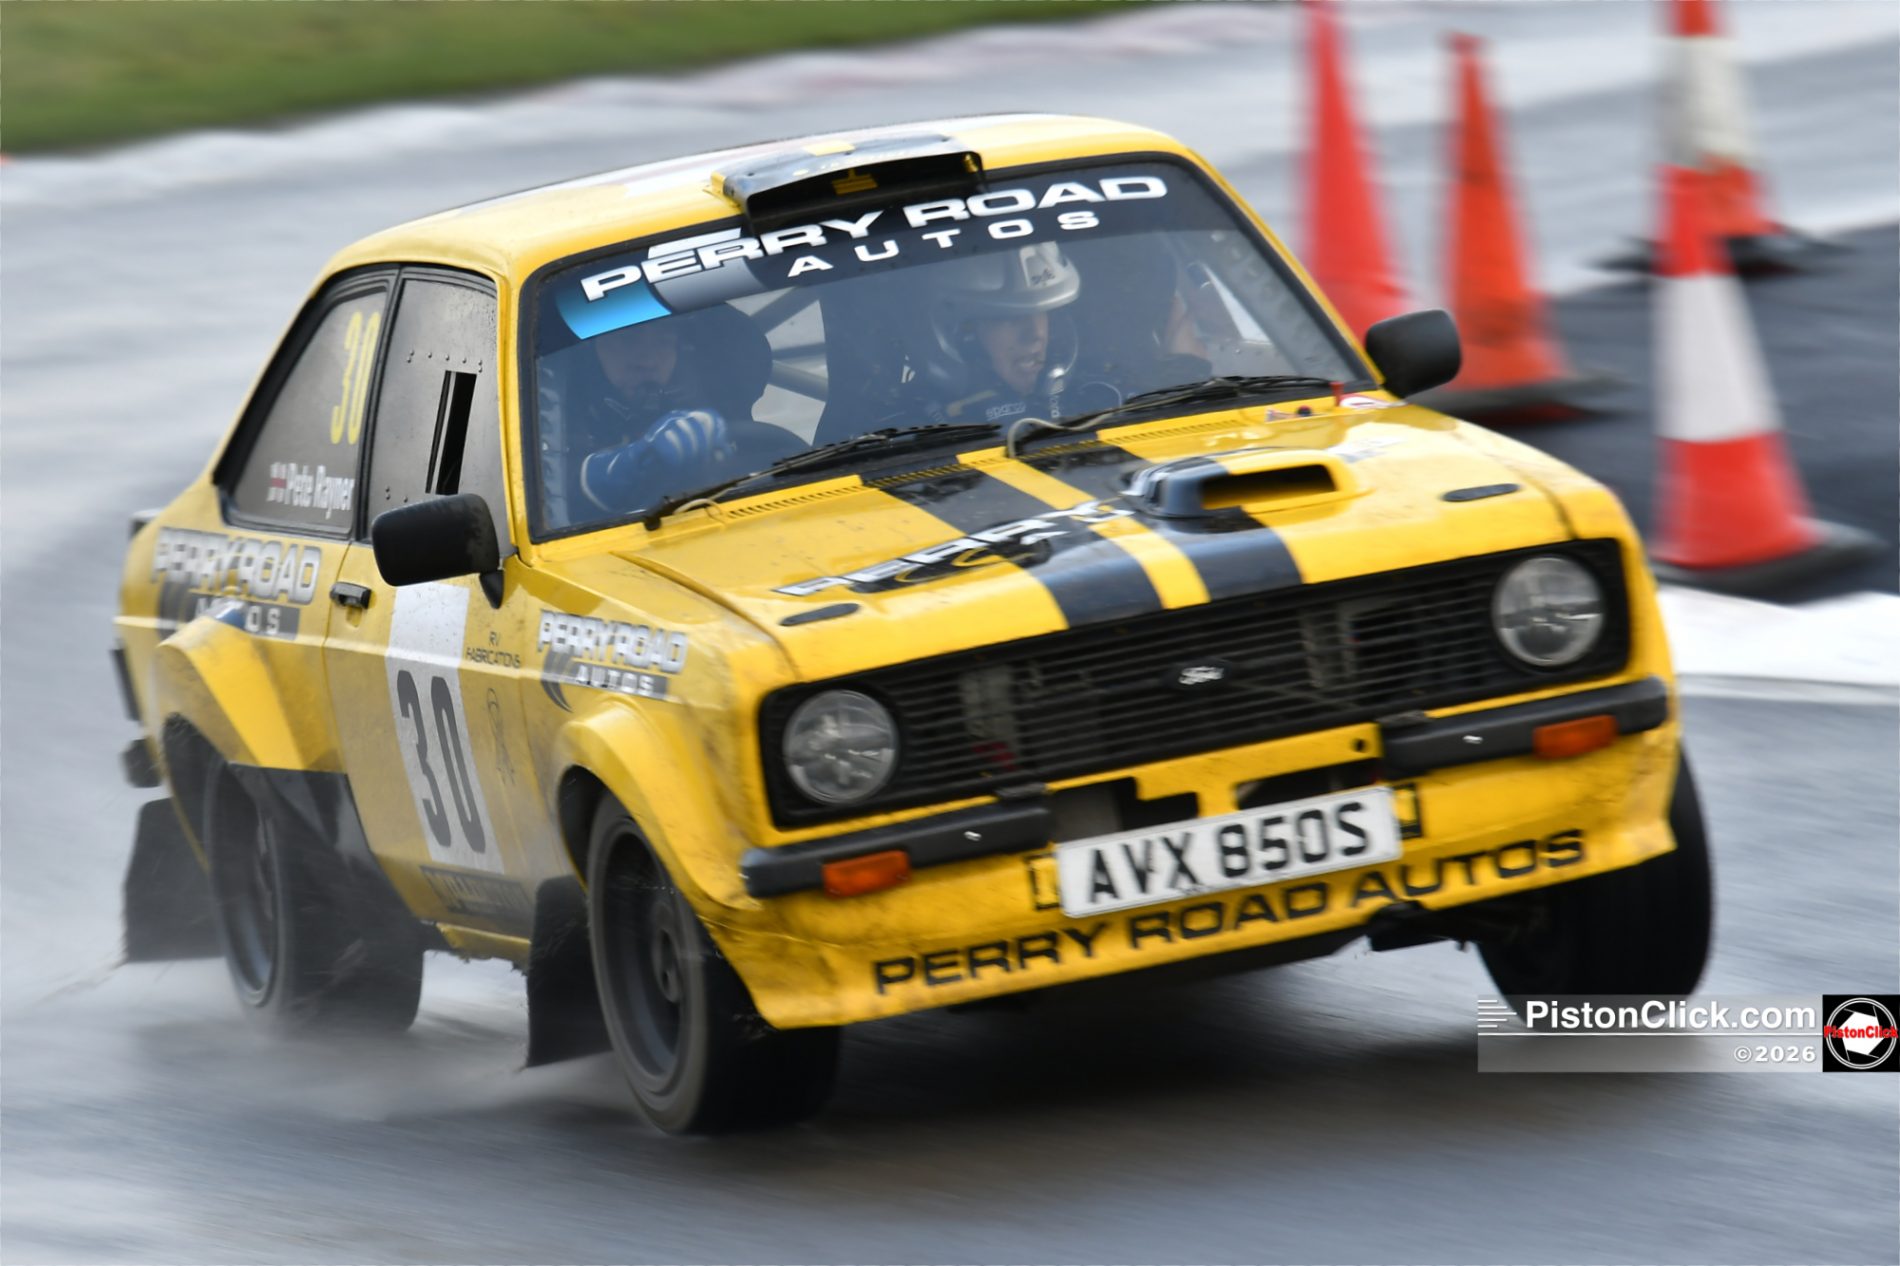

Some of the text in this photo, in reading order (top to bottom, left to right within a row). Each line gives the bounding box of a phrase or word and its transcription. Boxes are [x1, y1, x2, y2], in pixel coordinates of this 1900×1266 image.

[582, 175, 1167, 301] PERRY ROAD
[787, 210, 1101, 278] AUTOS
[331, 311, 381, 444] 30
[149, 526, 322, 605] PERRY ROAD
[537, 609, 688, 673] PERRY ROAD
[575, 665, 655, 697] AUTOS
[397, 669, 486, 854] 30
[1088, 801, 1370, 904] AVX 850S
[874, 830, 1585, 996] PERRY ROAD AUTOS
